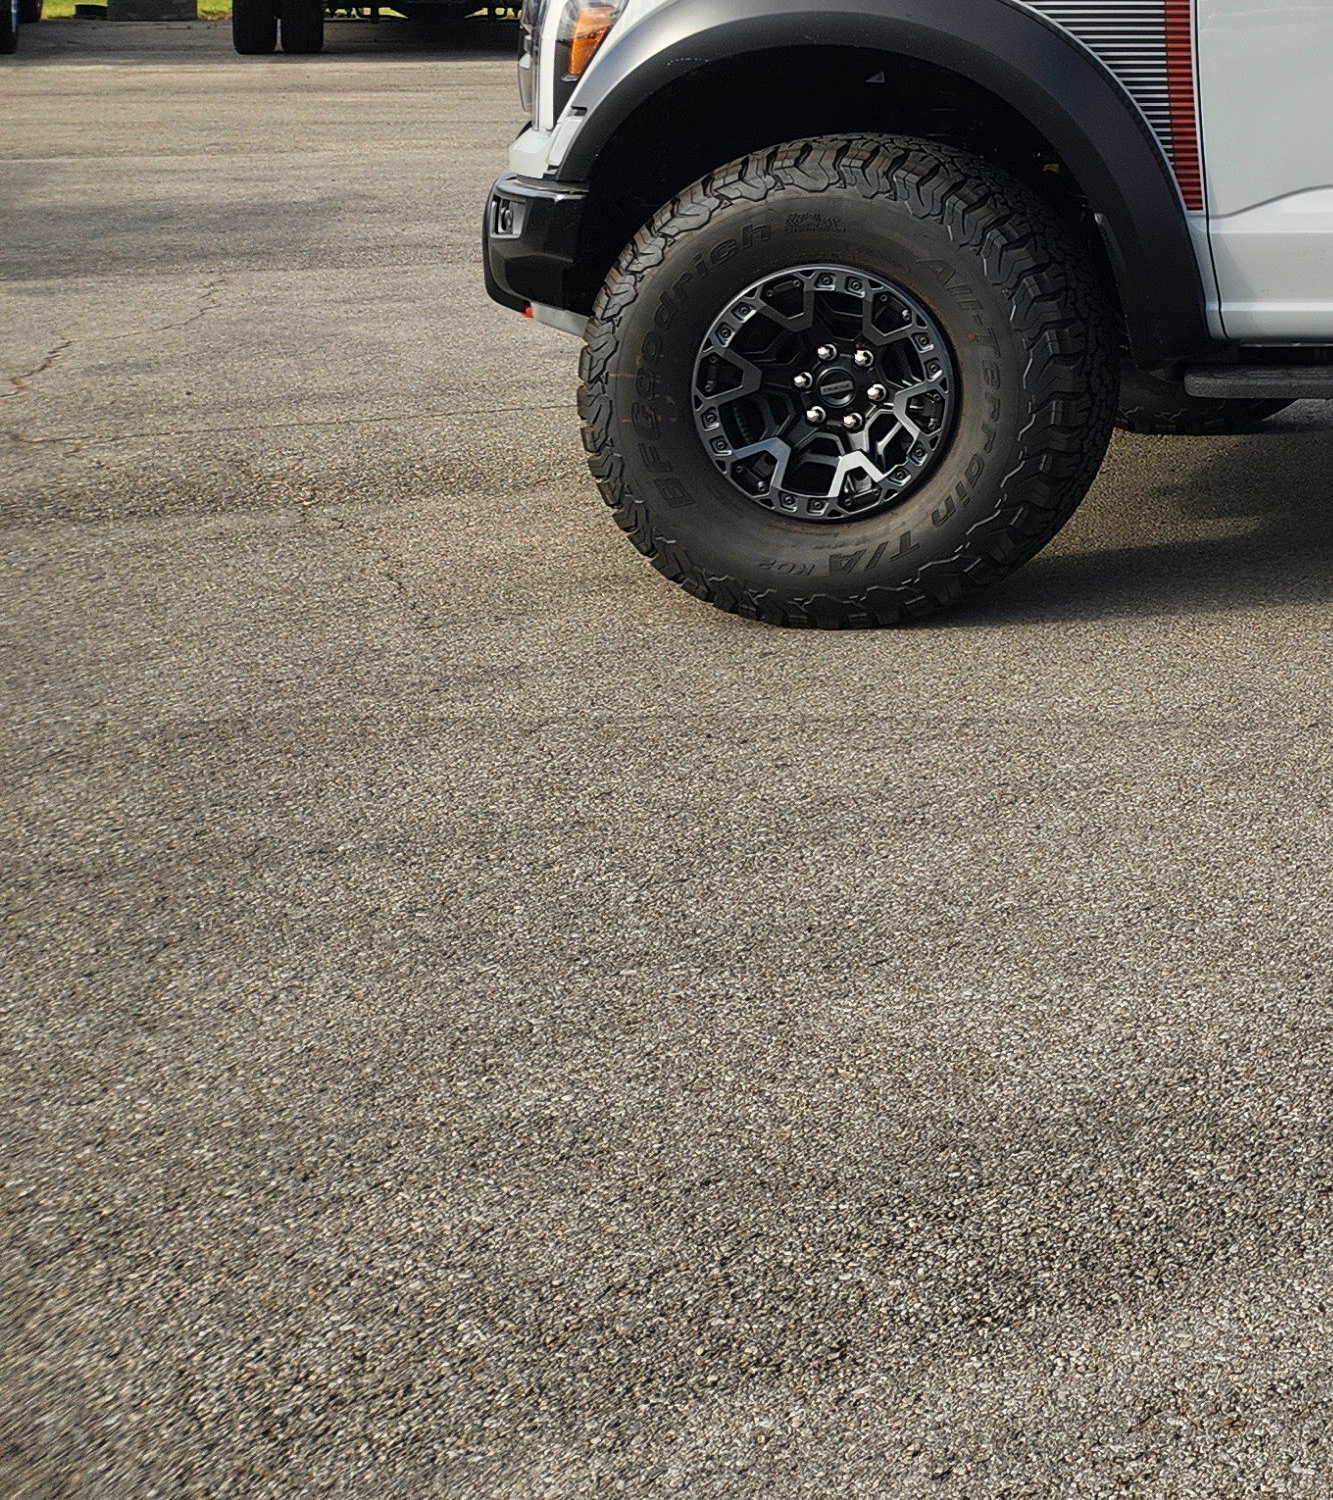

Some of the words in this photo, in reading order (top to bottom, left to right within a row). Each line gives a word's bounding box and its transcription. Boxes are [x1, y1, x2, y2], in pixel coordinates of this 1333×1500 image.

[631, 222, 773, 510] BFGoodrich
[915, 258, 1004, 527] All-Terrain
[828, 531, 921, 575] T/A
